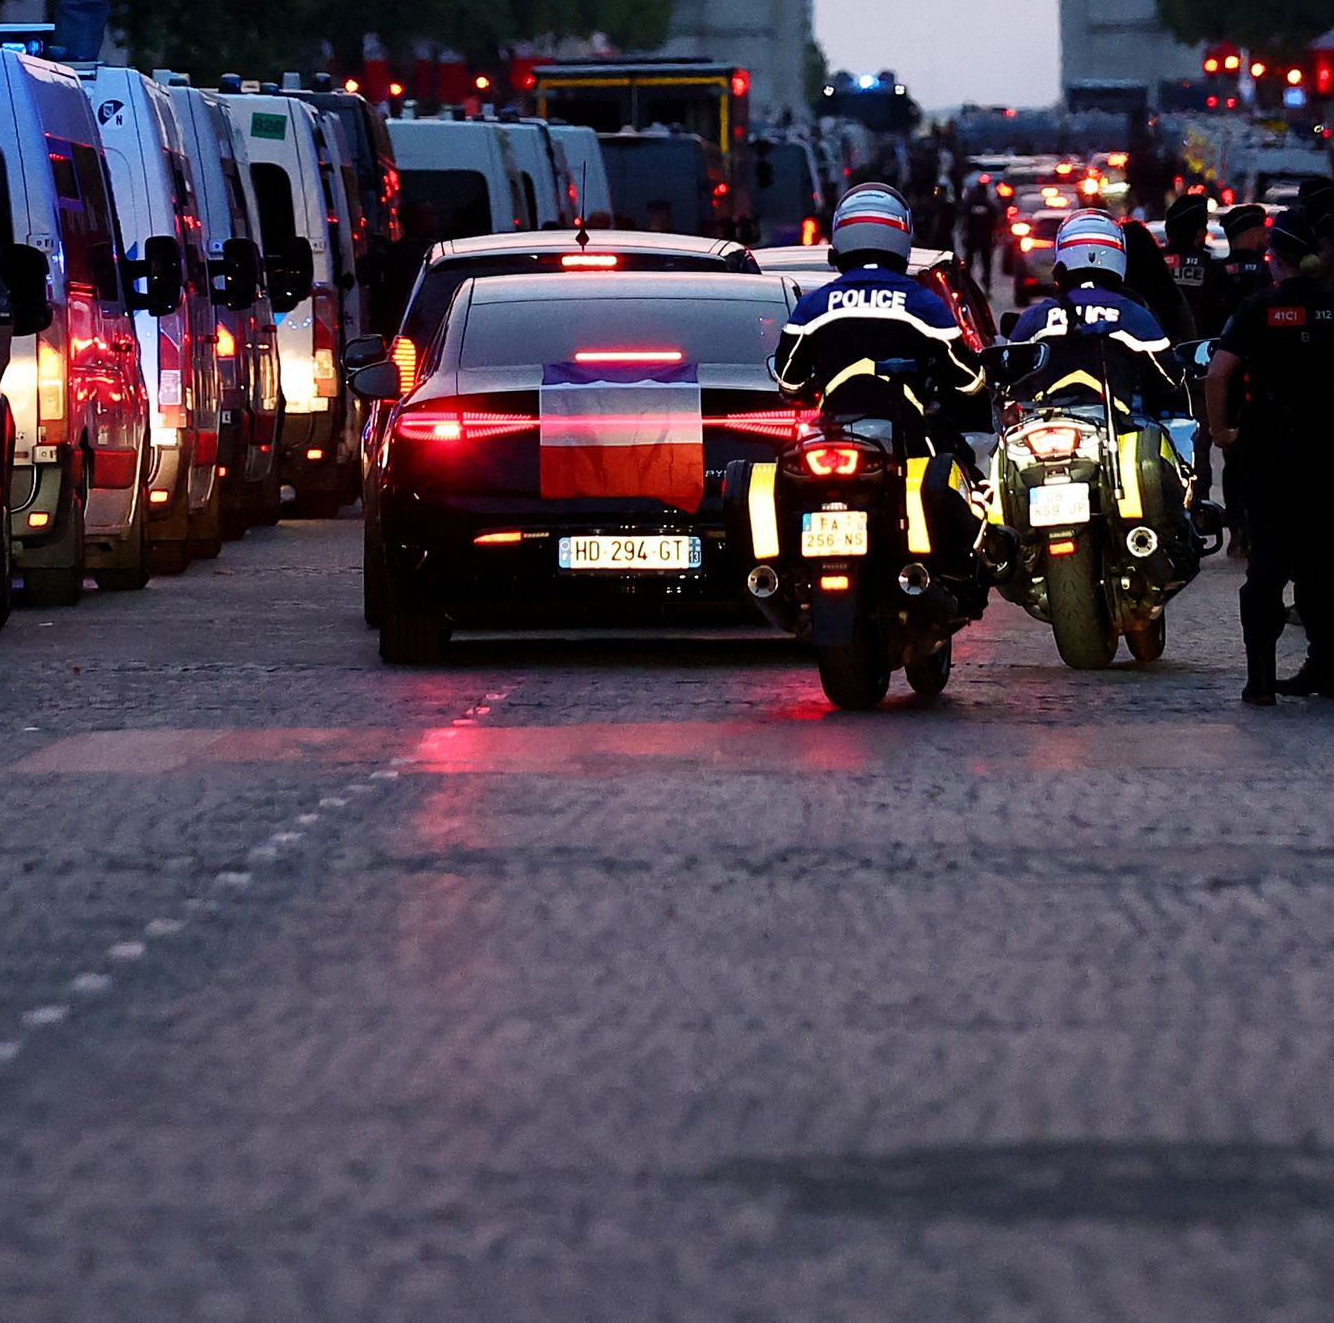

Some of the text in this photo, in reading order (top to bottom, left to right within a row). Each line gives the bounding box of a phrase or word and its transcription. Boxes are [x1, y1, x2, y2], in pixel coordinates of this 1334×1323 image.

[116, 115, 123, 125] N
[828, 289, 907, 311] POLICE
[1315, 310, 1333, 320] 312
[821, 517, 838, 531] FA
[689, 551, 699, 563] 13
